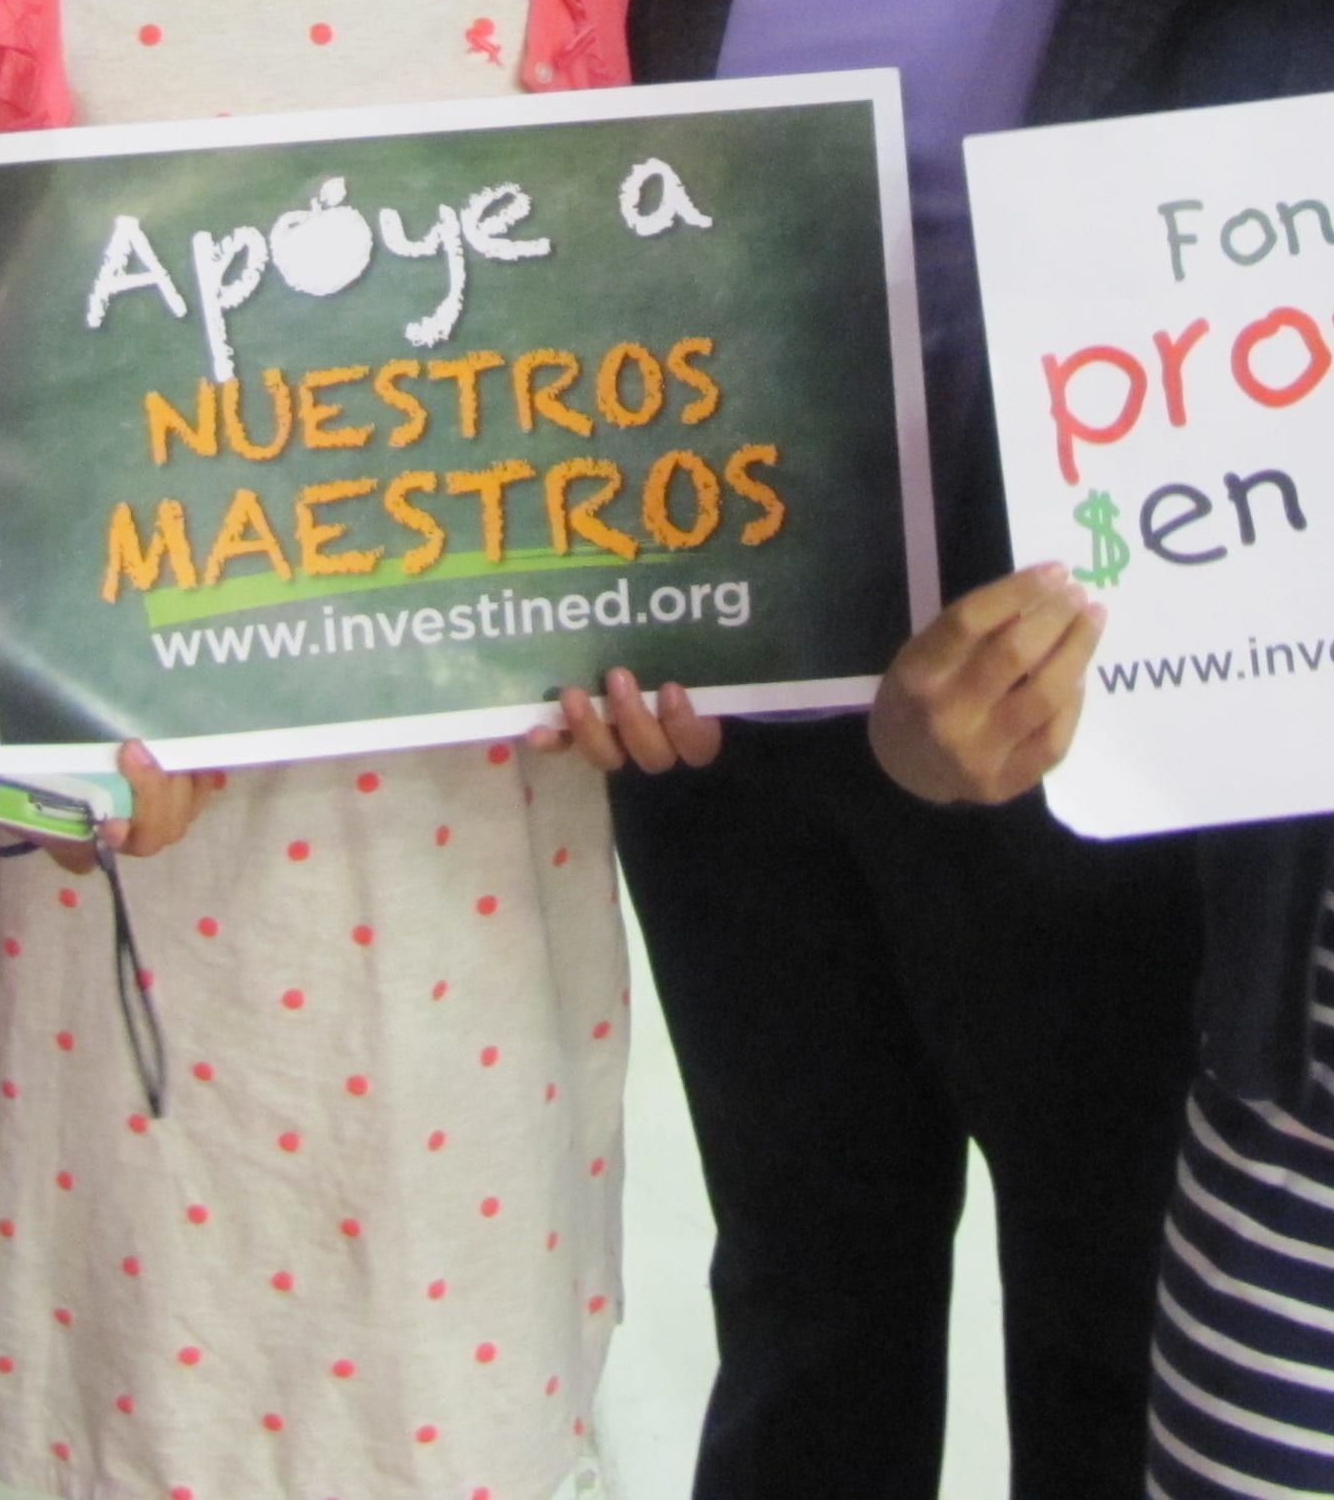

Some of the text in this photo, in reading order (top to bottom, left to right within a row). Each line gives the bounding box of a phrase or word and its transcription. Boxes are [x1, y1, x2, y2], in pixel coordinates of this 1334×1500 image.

[619, 157, 713, 237] a
[143, 337, 722, 465] NUESTROS
[100, 444, 786, 605] MAESTROS
[151, 577, 751, 669] www.investined.org
